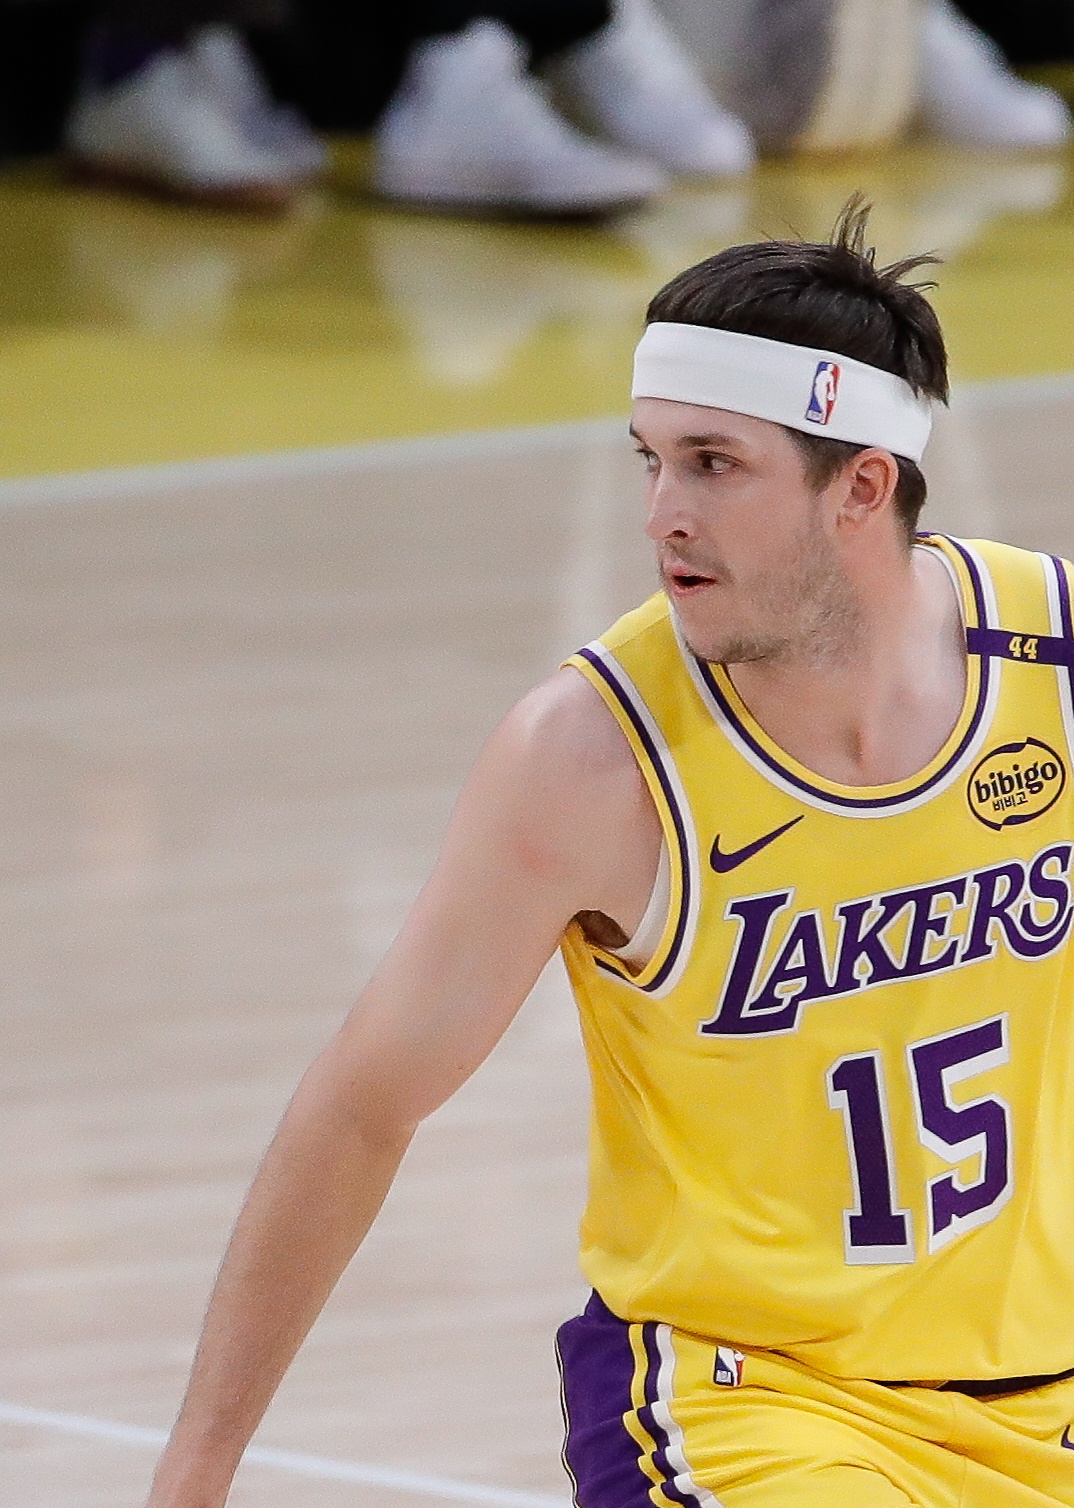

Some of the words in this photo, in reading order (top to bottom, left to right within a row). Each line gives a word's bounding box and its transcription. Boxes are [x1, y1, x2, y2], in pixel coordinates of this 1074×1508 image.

[1008, 636, 1039, 660] 44
[974, 761, 1059, 804] bibigo
[992, 792, 1029, 812] 비비고
[825, 1012, 1015, 1266] 15
